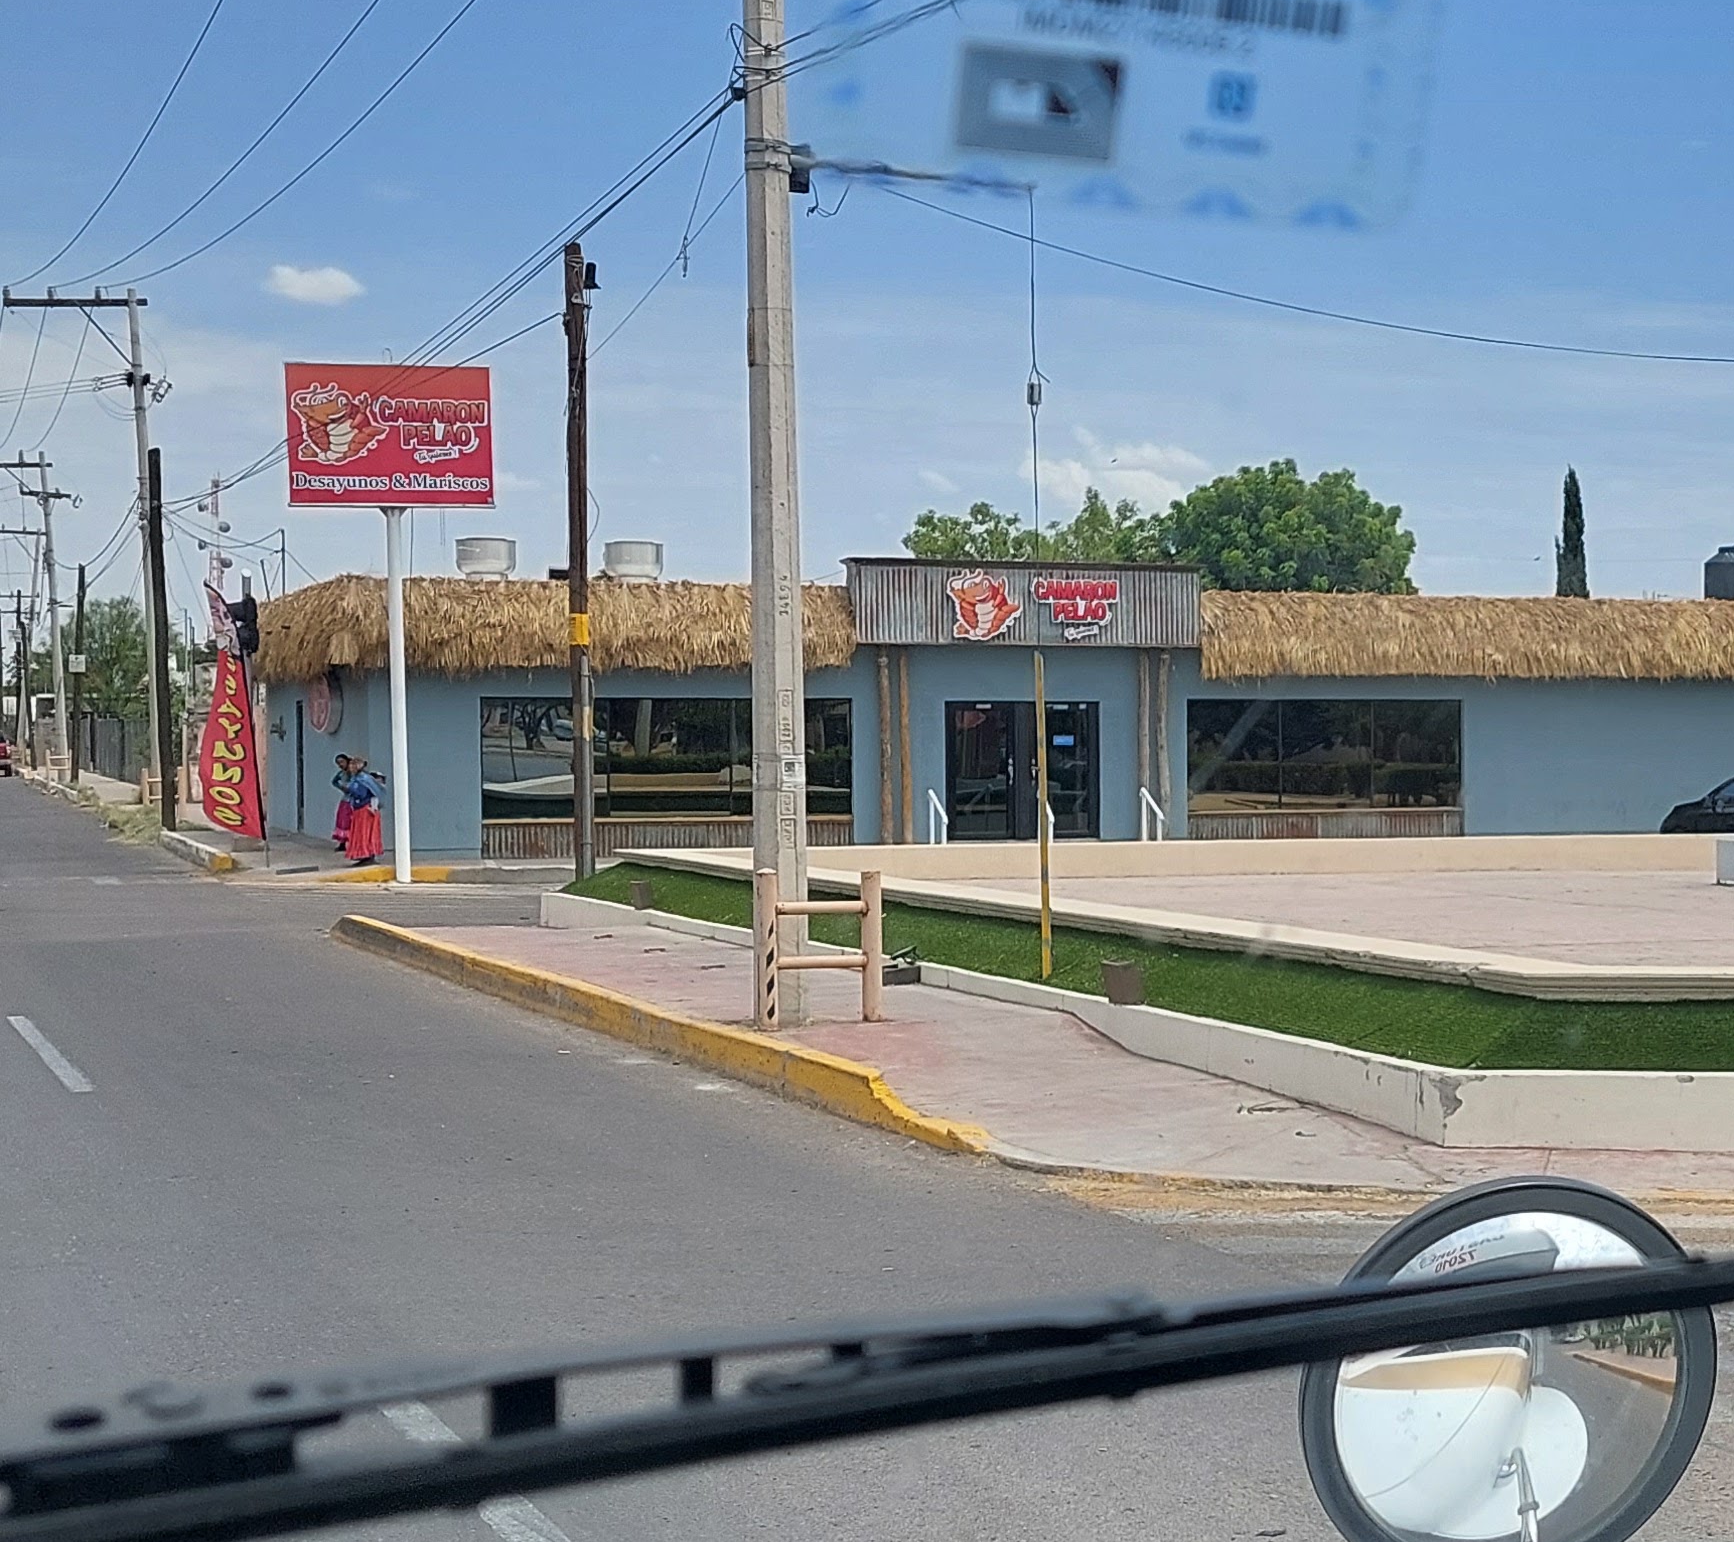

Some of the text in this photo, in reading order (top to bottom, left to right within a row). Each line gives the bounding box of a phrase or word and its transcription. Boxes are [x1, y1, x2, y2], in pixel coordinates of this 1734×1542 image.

[379, 399, 486, 425] CAMARON
[402, 424, 472, 447] PELAO
[294, 473, 489, 492] Desayunos & Mariscos
[1034, 579, 1118, 601] CAMARON
[1052, 601, 1107, 621] PELAO
